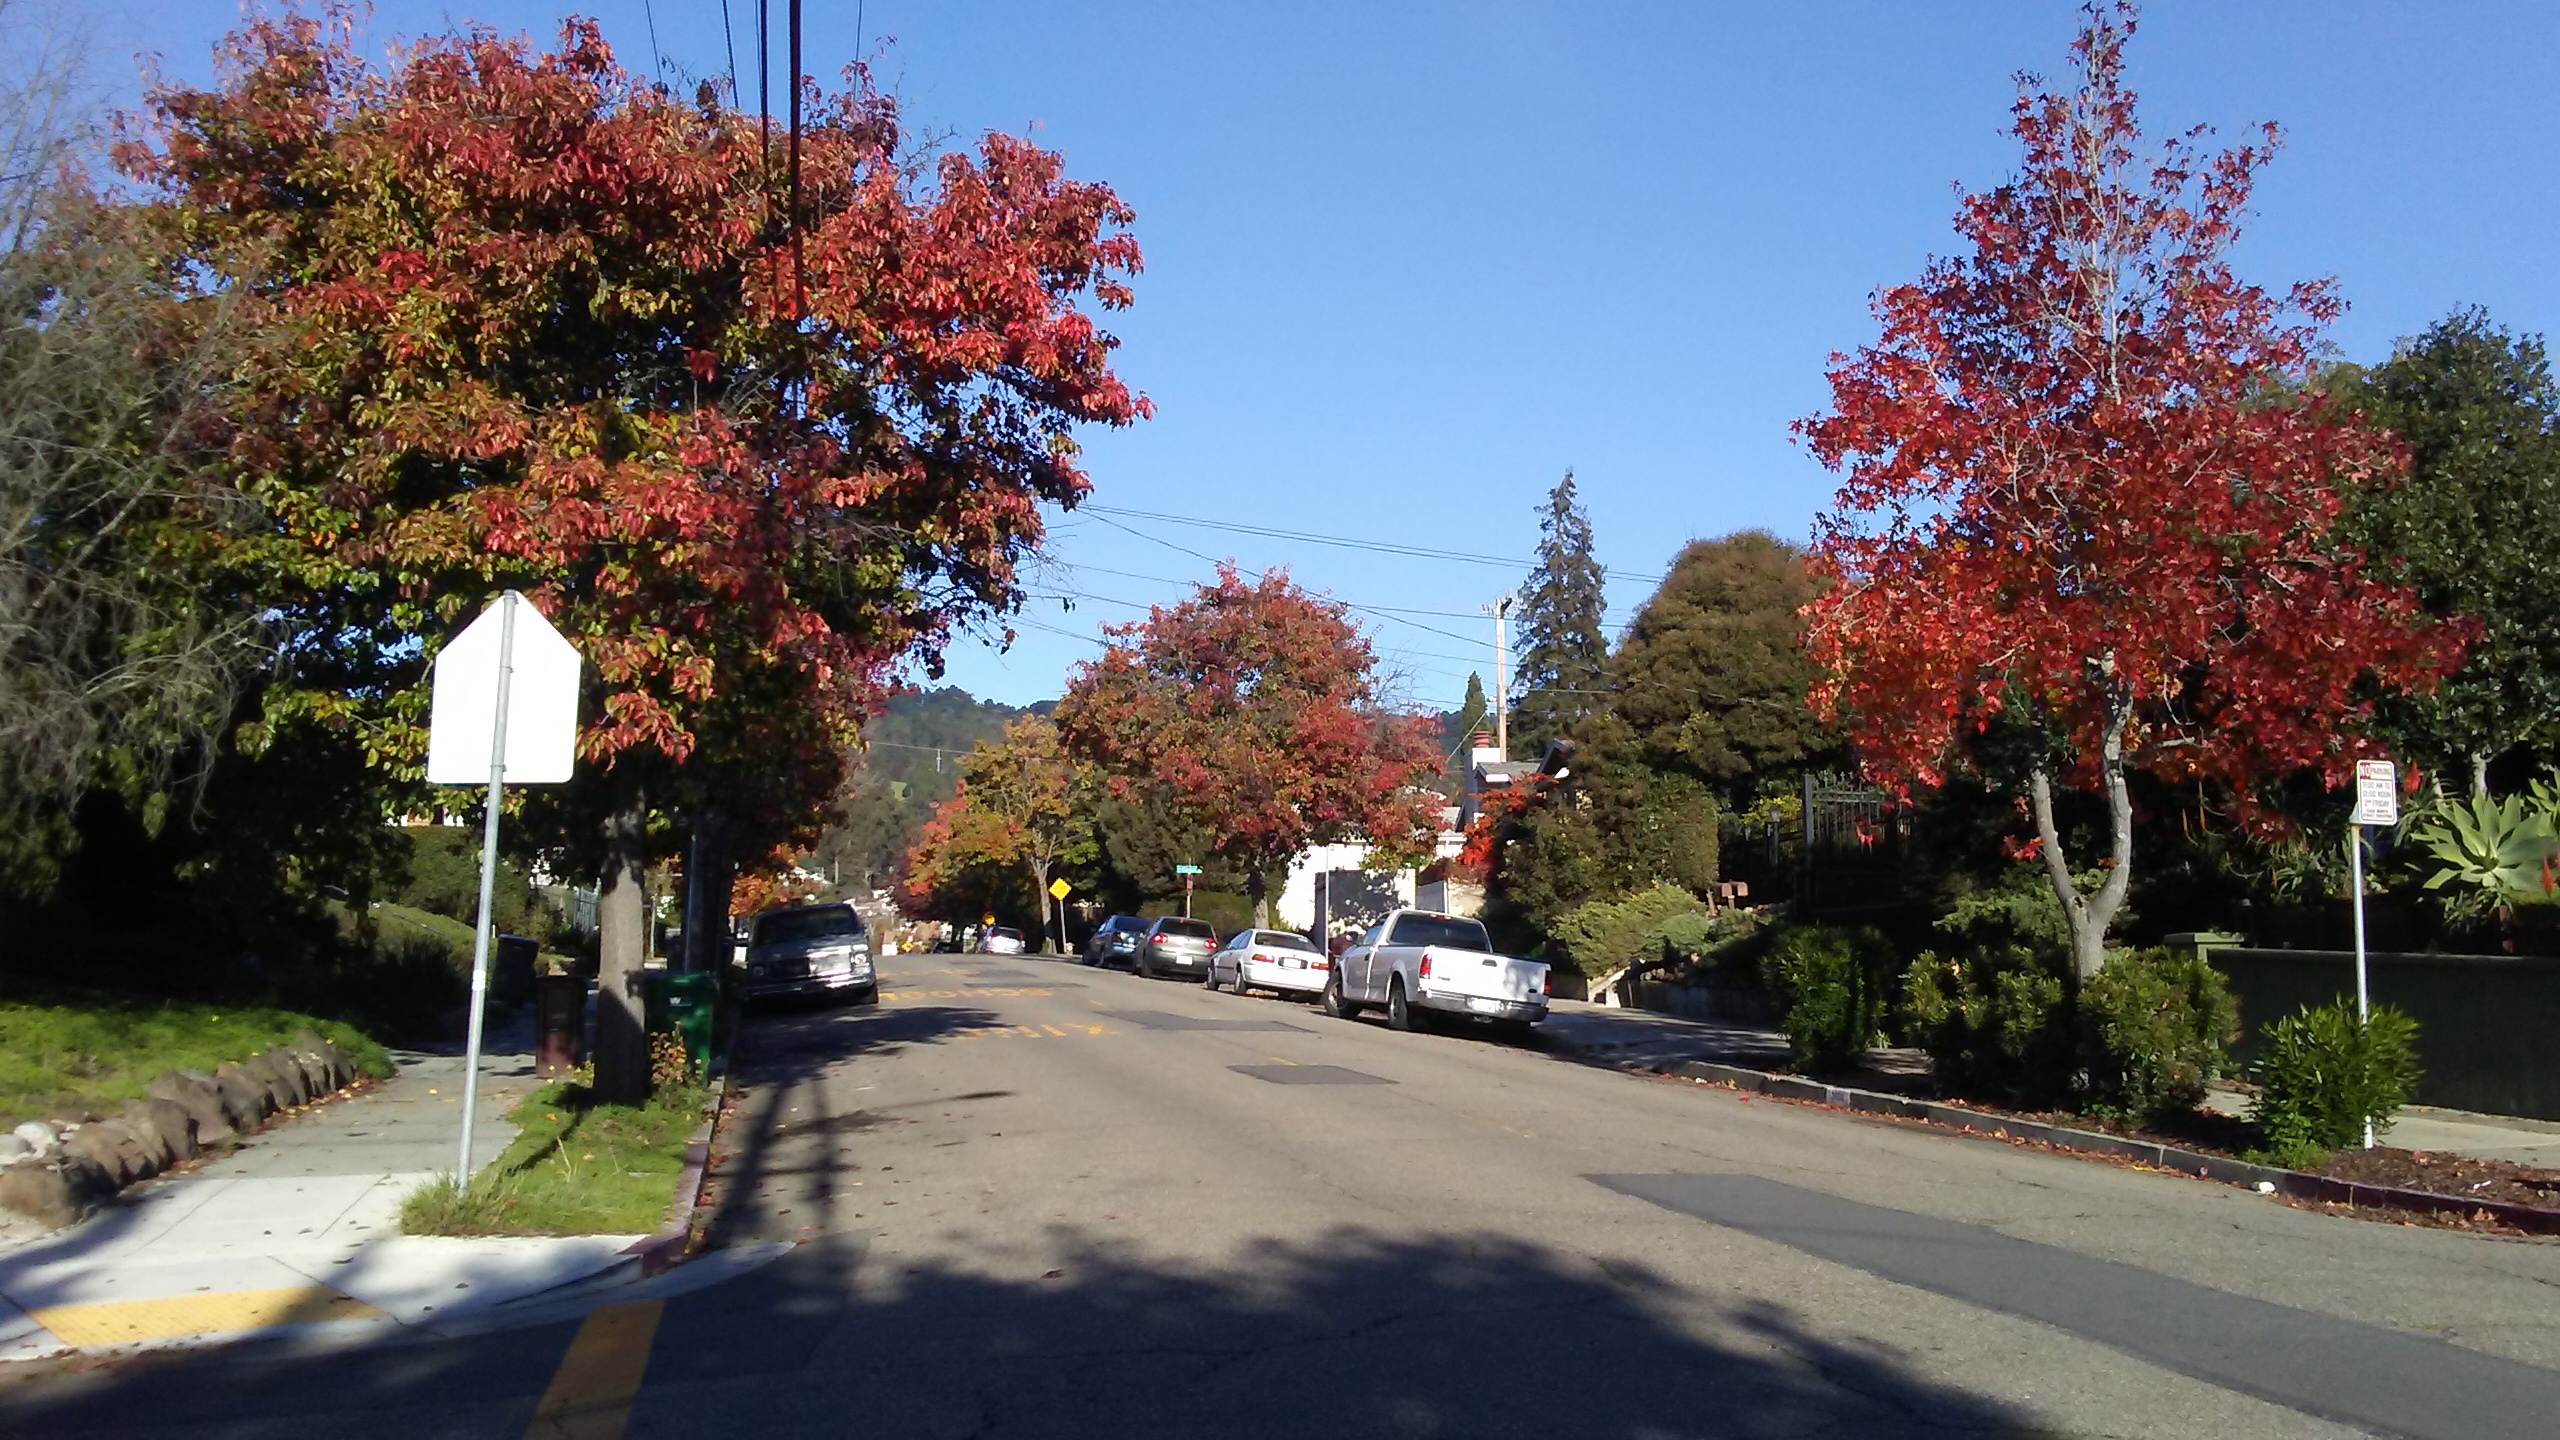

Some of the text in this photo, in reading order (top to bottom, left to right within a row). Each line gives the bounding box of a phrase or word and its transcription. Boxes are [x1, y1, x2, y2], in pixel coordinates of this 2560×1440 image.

[2359, 764, 2391, 776] NO PARKING
[2378, 790, 2391, 798] NOON
